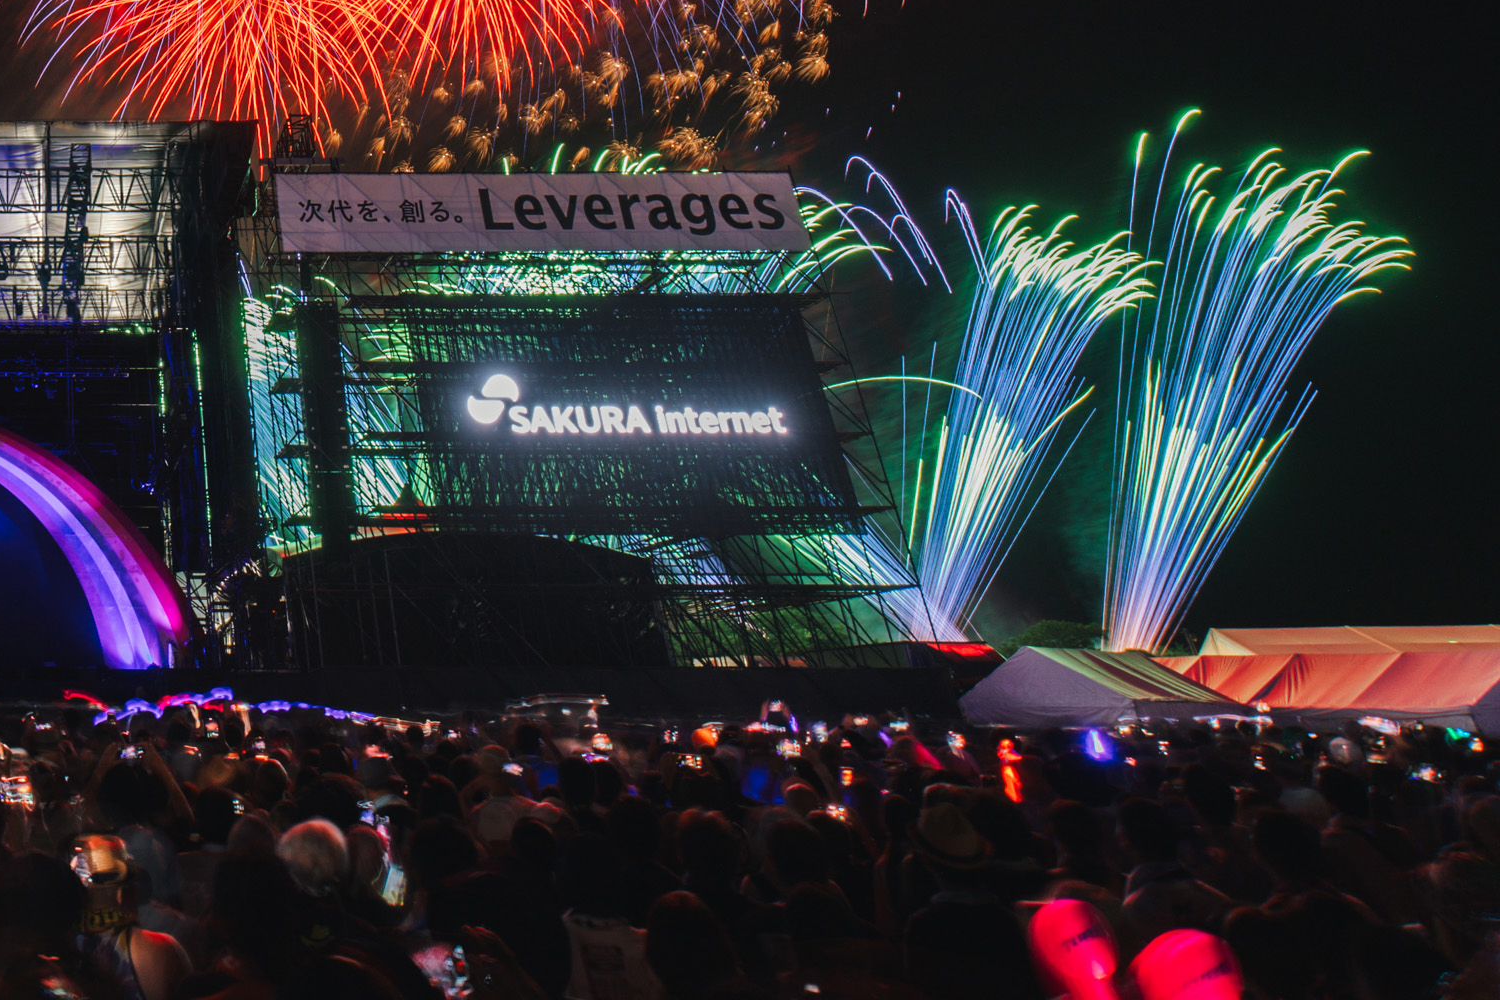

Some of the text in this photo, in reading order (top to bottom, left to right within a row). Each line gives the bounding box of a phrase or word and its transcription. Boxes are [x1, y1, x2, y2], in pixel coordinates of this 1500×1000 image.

[298, 198, 465, 225] 次代を、創る。
[479, 188, 786, 236] Leverages
[509, 406, 787, 435] SAKURA internet
